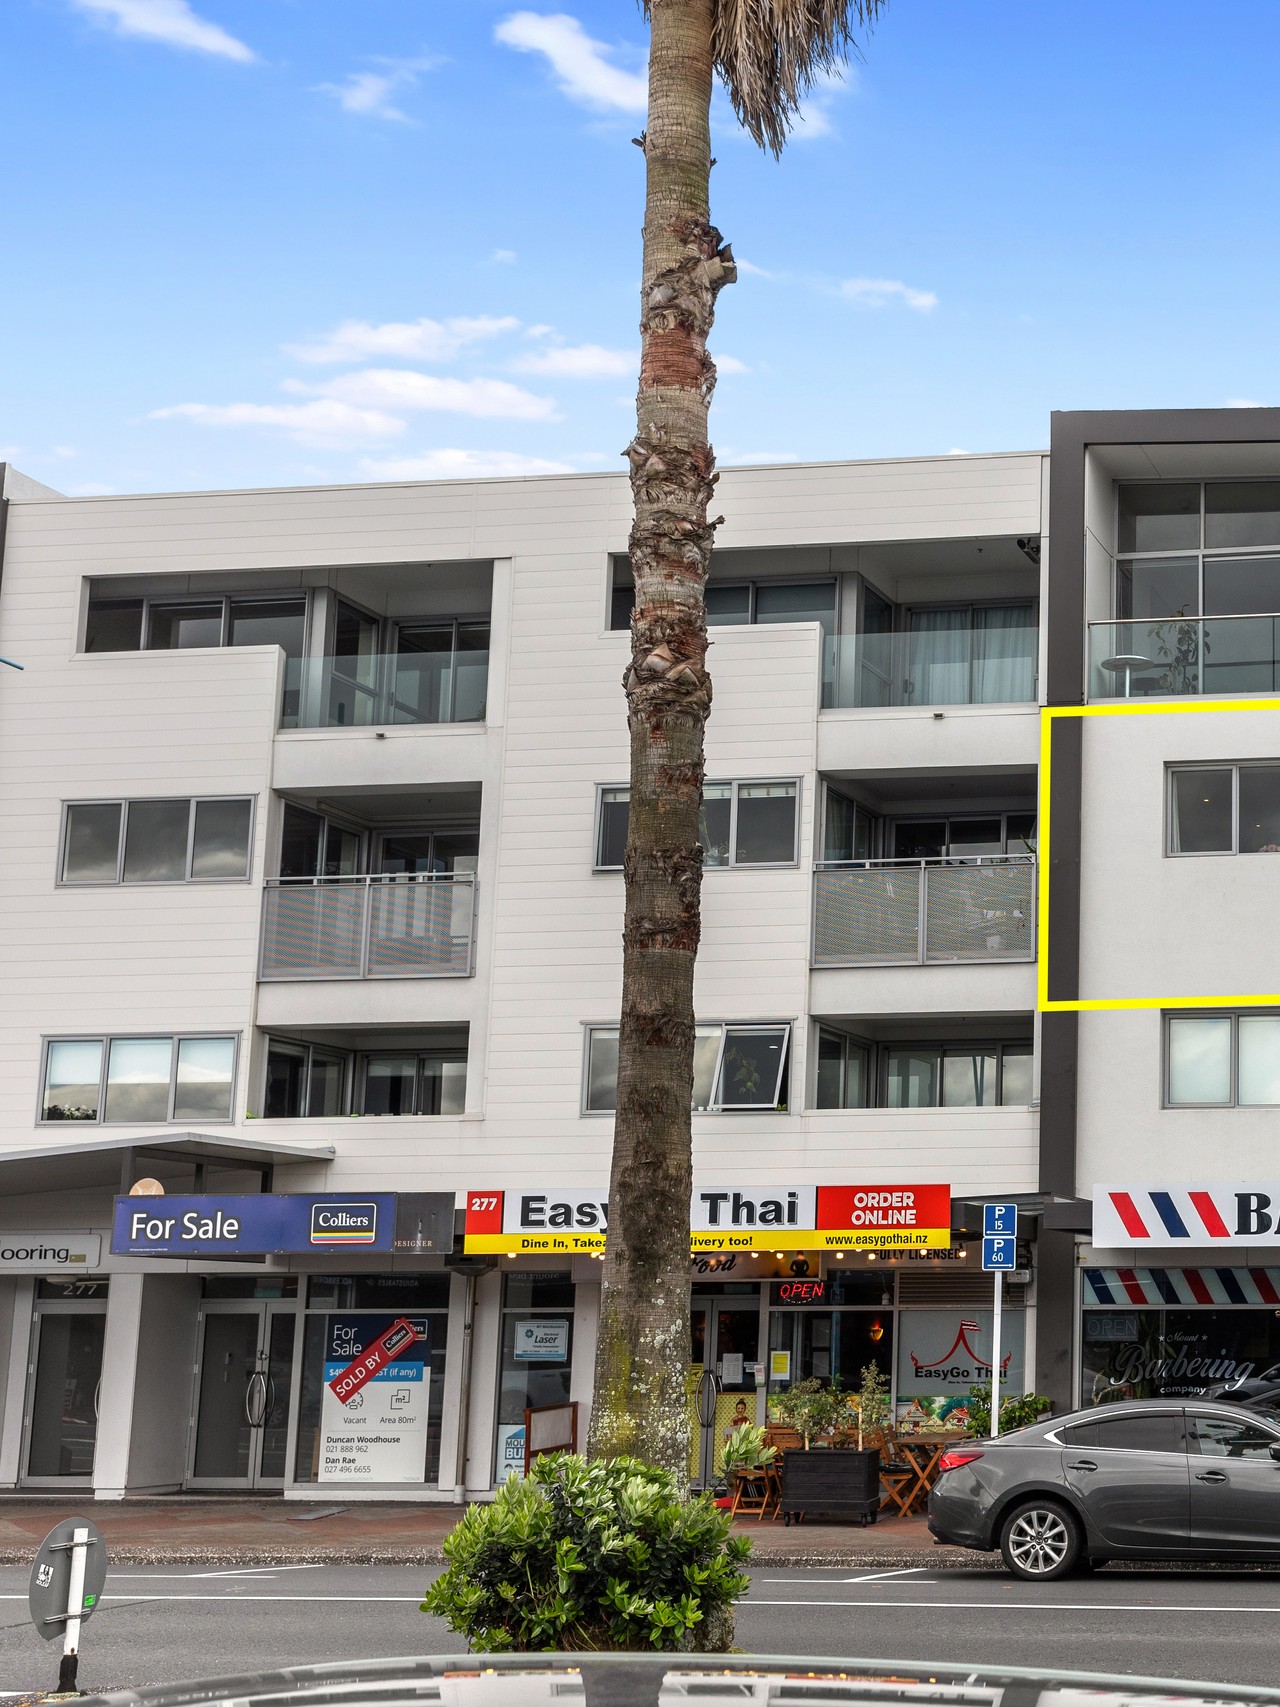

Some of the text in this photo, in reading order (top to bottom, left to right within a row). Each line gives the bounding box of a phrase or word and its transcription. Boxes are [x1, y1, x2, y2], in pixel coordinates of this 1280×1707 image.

[471, 1198, 498, 1211] 277
[853, 1192, 915, 1208] ORDER
[700, 1191, 799, 1226] Thai
[995, 1206, 1006, 1219] P
[319, 1212, 369, 1227] Colliers
[851, 1209, 917, 1226] ONLINE
[131, 1211, 239, 1240] For Sale
[994, 1220, 1004, 1230] 15
[521, 1239, 549, 1249] Dine
[553, 1239, 569, 1250] In,
[729, 1236, 753, 1246] too!
[825, 1232, 928, 1247] www.easygothai.nz
[994, 1239, 1005, 1252] P
[992, 1252, 1004, 1262] 60
[63, 1284, 97, 1295] 277
[780, 1283, 824, 1297] OPEN
[333, 1325, 358, 1340] For
[1087, 1318, 1137, 1336] OPEN
[385, 1330, 407, 1348] Colliers
[534, 1335, 558, 1343] Laser
[1166, 1331, 1199, 1342] Mount
[332, 1340, 362, 1356] Sale
[336, 1352, 381, 1396] SOLD BY
[390, 1368, 398, 1377] (if
[400, 1368, 417, 1378] any)
[915, 1367, 969, 1380] EasyGo
[1109, 1344, 1256, 1391] Barbering
[340, 1445, 354, 1453] 888
[355, 1445, 369, 1453] 962
